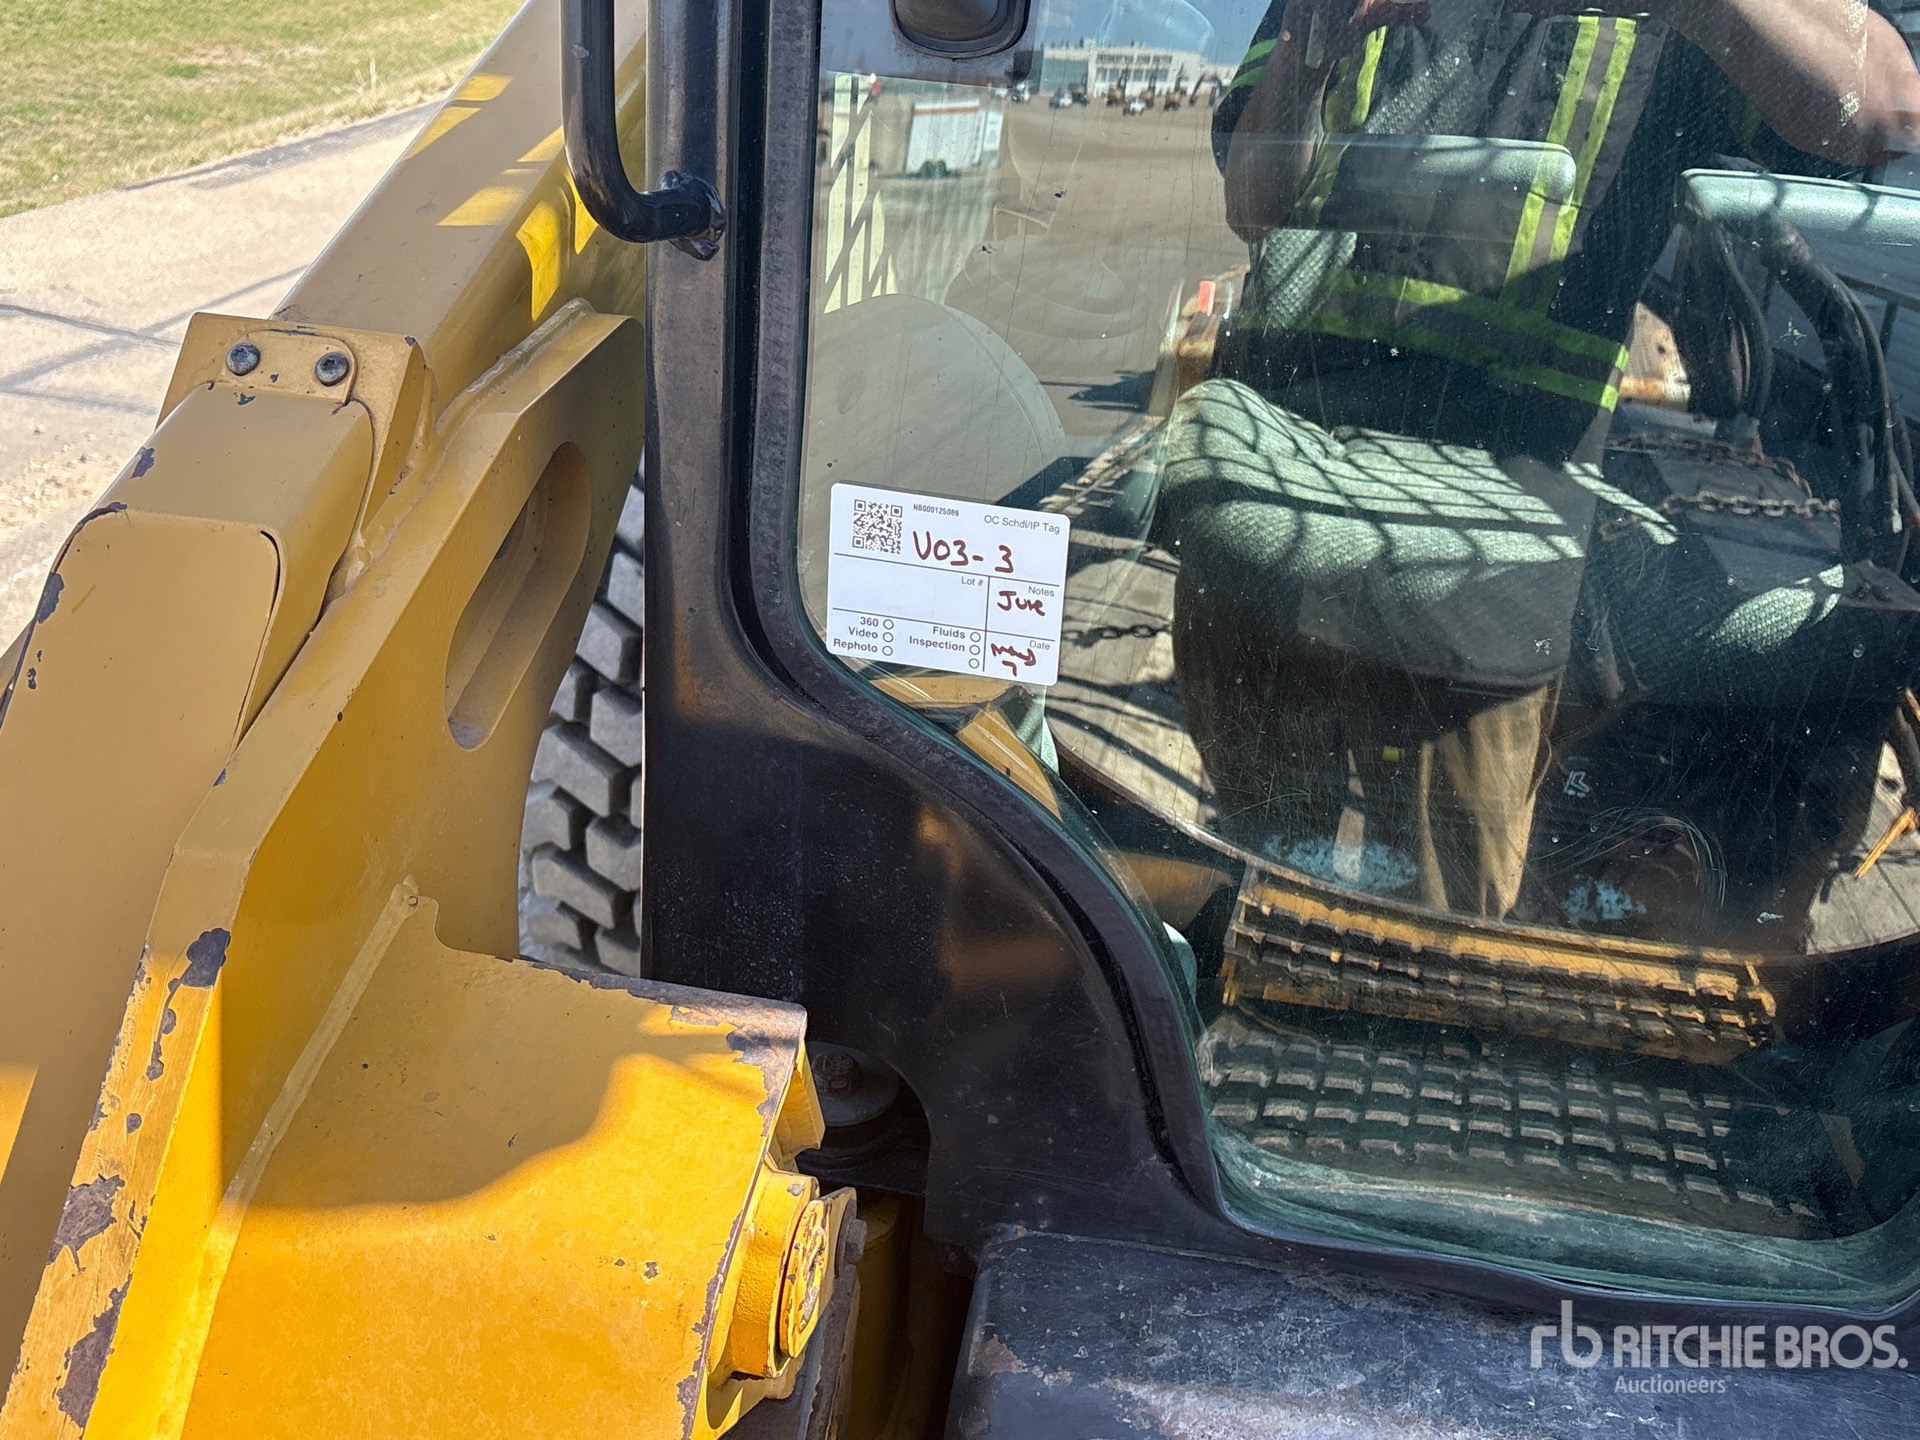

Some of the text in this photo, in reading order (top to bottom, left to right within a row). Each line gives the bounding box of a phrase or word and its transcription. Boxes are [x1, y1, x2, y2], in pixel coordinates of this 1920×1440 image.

[912, 503, 960, 518] NB000125086
[984, 514, 1000, 525] OC
[1043, 521, 1061, 535] Tag
[961, 576, 984, 587] Lot #
[1028, 586, 1055, 597] Notes
[859, 616, 880, 628] 360
[848, 626, 879, 640] Video
[932, 626, 966, 640] Fluids
[832, 638, 878, 653] Rephoto
[909, 635, 966, 653] Inspection
[1029, 639, 1051, 651] Date
